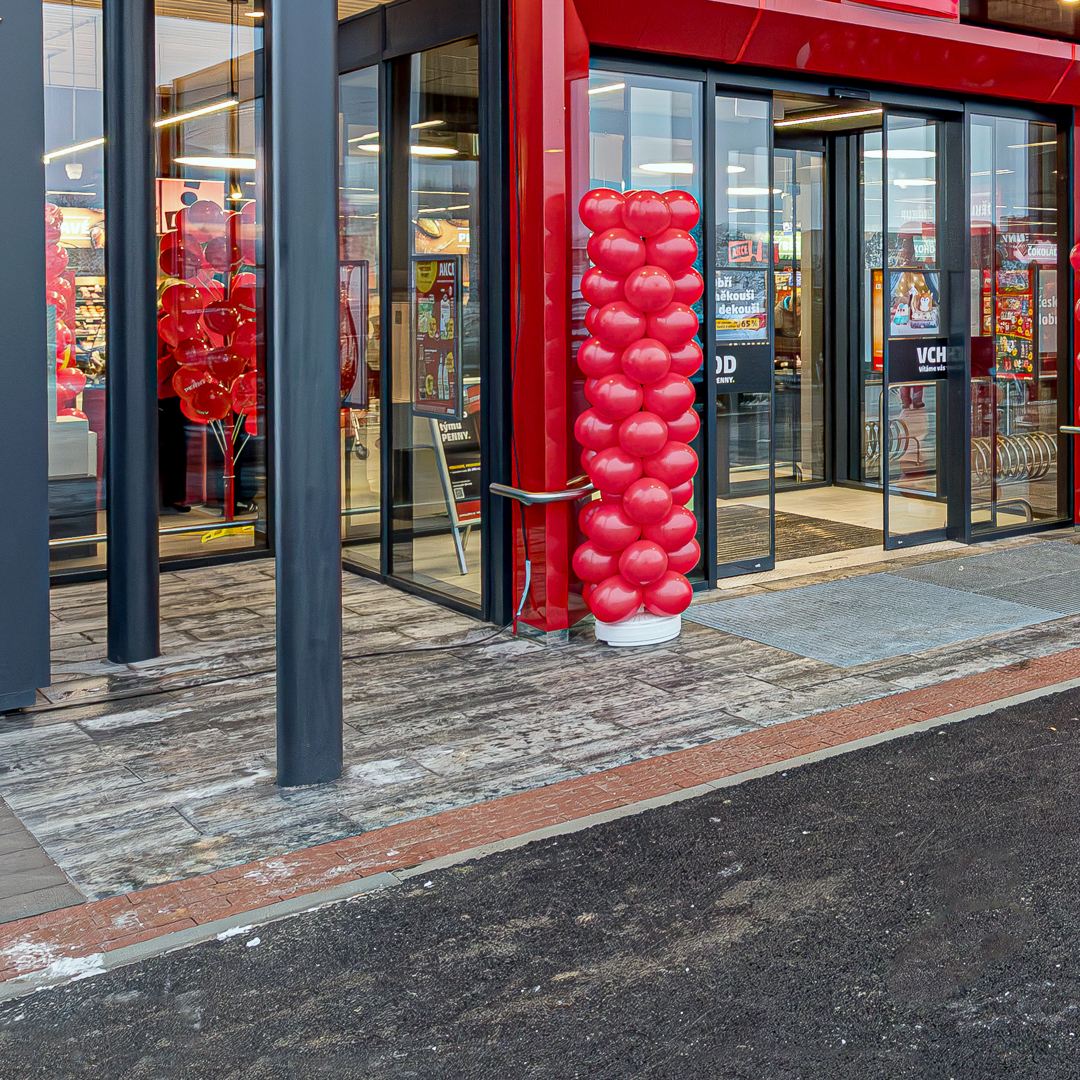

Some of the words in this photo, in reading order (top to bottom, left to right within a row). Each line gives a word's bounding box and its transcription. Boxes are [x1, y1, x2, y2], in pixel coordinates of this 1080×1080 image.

[715, 276, 732, 288] bří
[718, 302, 760, 315] dekouši
[741, 320, 751, 328] 65
[916, 346, 947, 364] VCH
[716, 376, 735, 384] ENNY.
[439, 421, 463, 433] týmu
